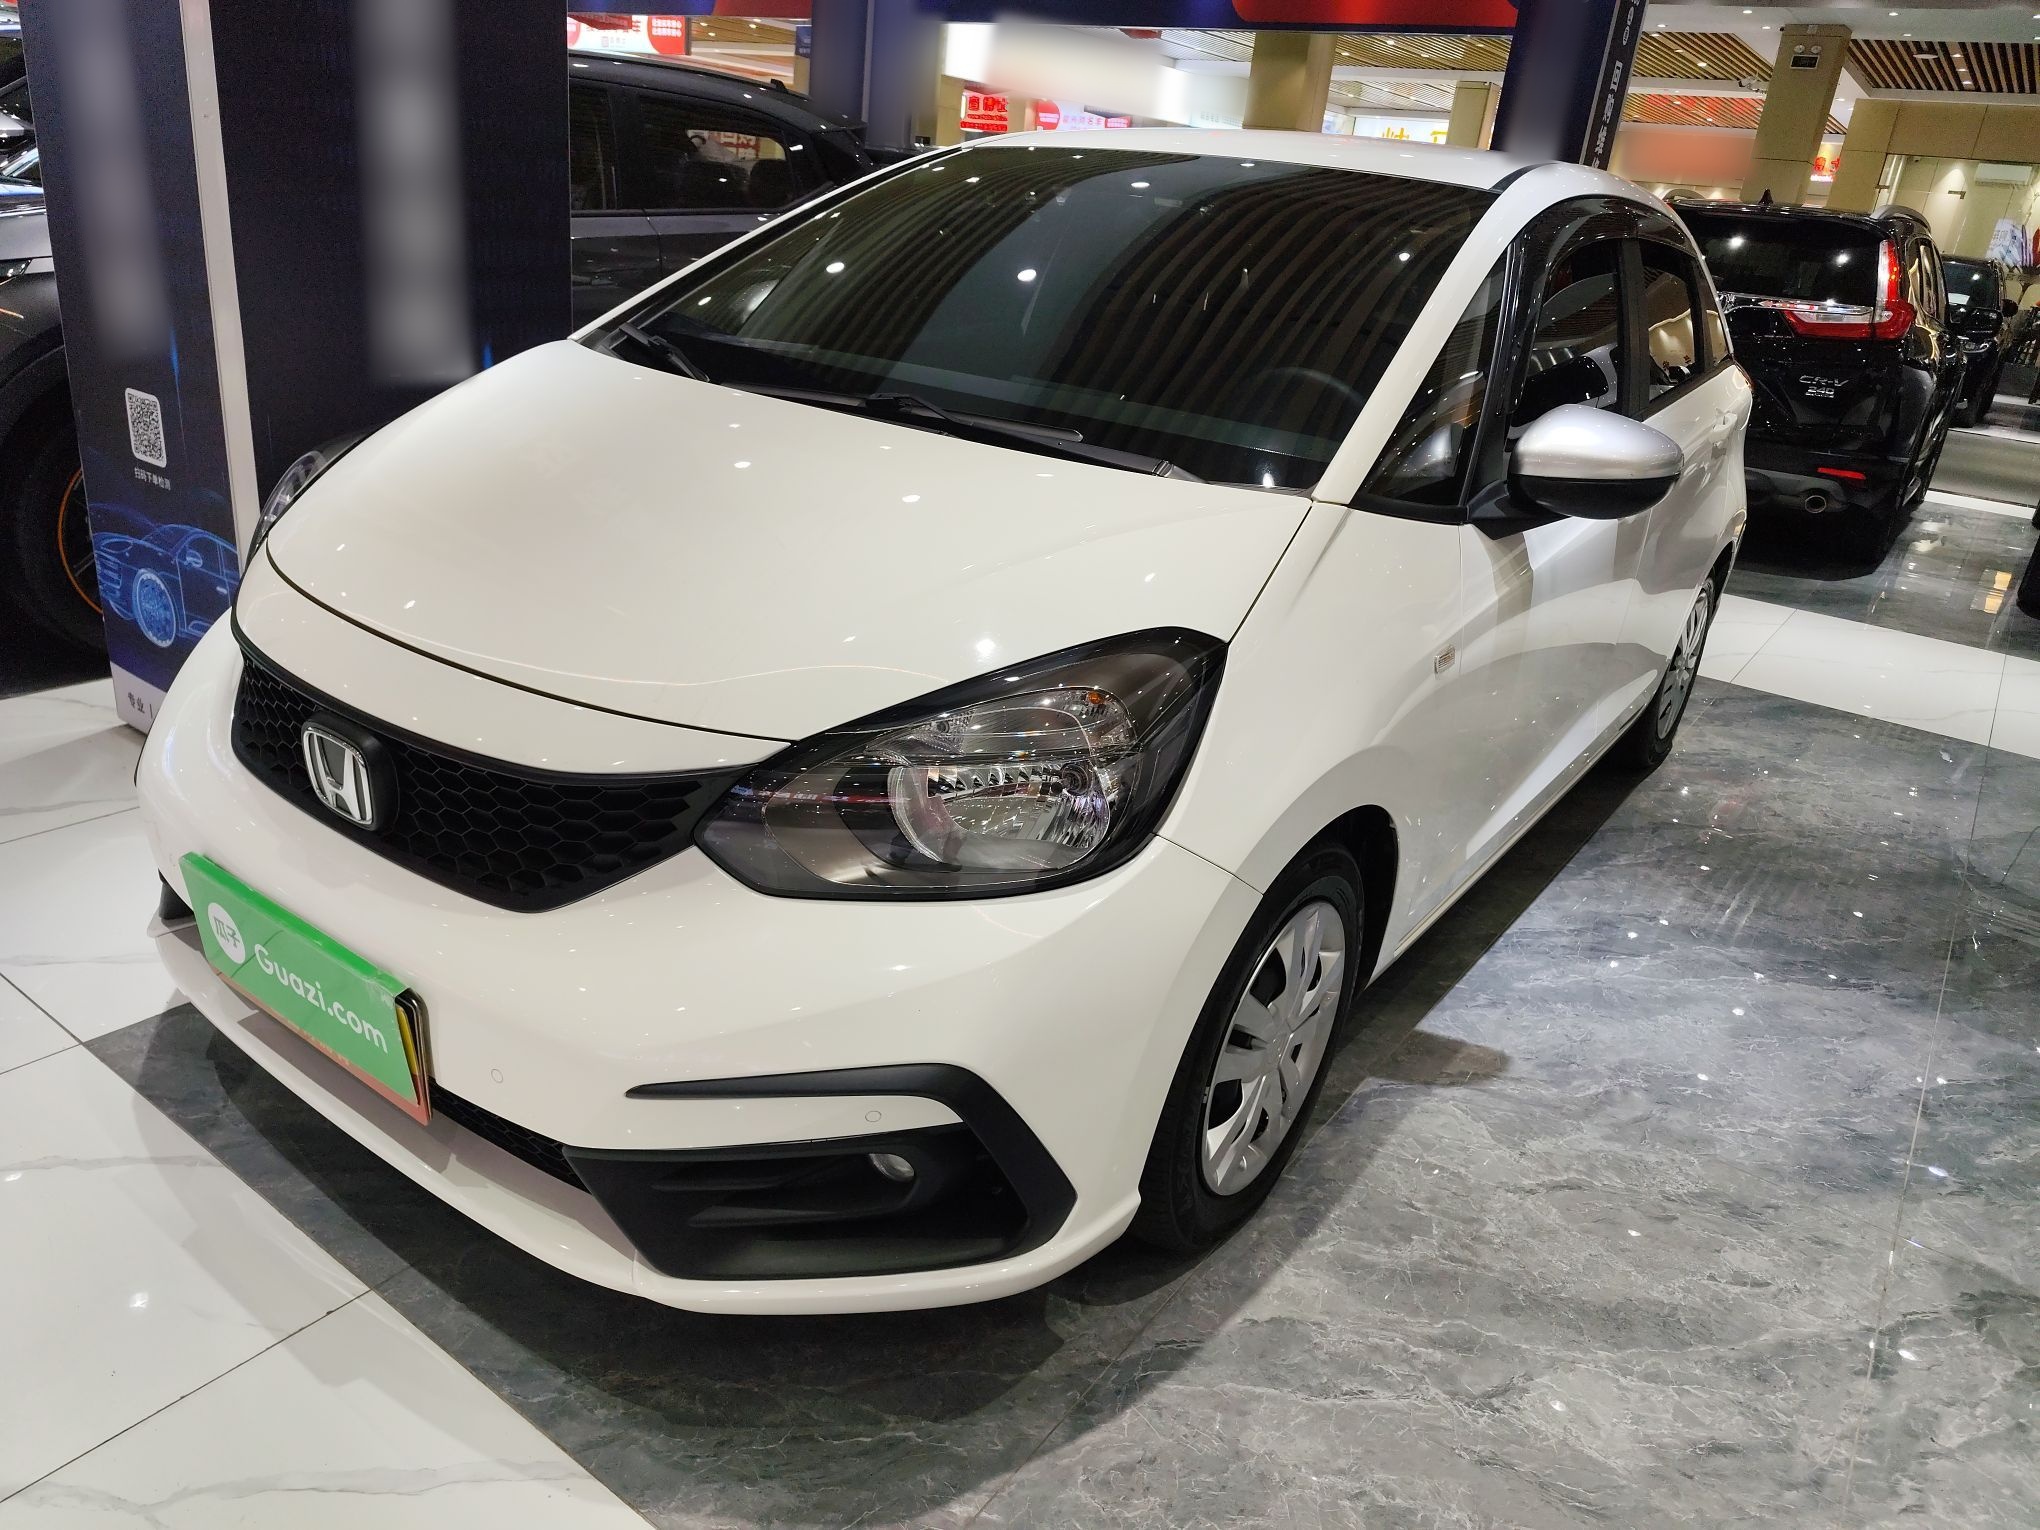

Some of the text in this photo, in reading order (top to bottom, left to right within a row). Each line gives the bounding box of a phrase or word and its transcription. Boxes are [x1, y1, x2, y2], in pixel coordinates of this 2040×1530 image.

[1799, 375, 1849, 387] CR-V
[213, 914, 241, 949] 瓜子
[254, 943, 389, 1054] Guazi.com
